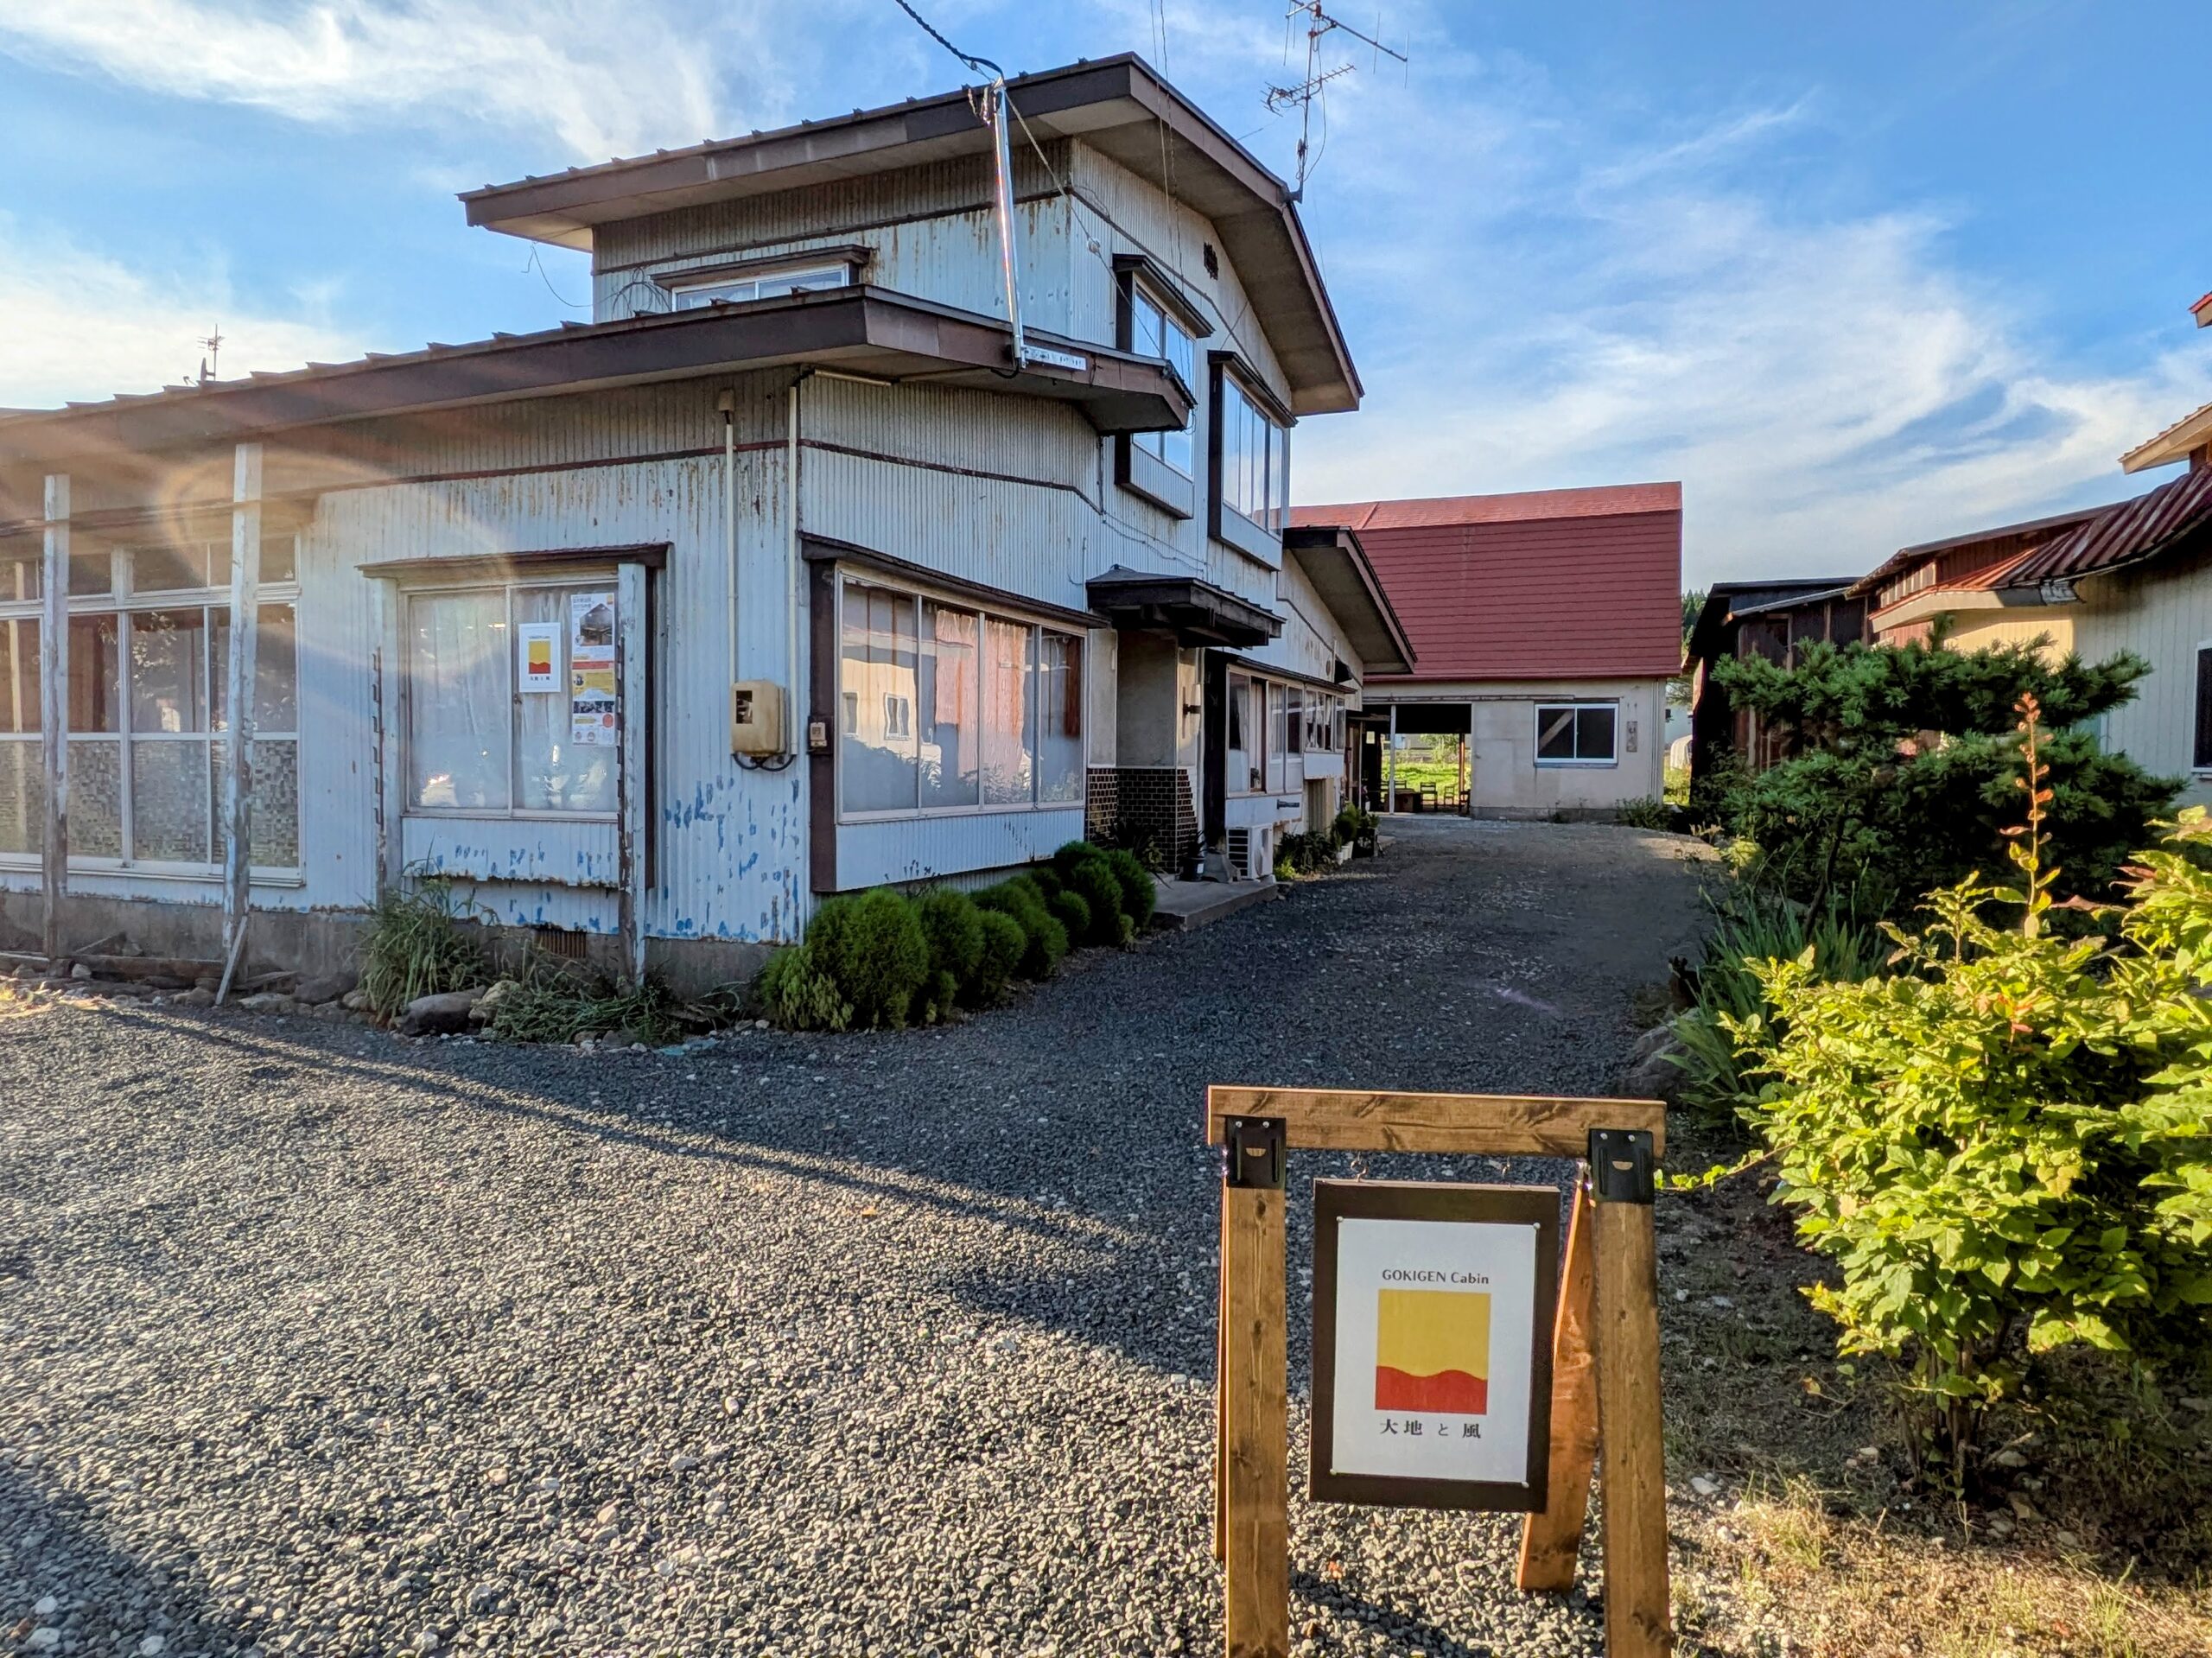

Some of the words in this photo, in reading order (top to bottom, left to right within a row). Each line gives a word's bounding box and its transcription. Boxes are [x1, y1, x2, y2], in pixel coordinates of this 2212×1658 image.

[1382, 1269, 1446, 1282] GOKIGEN
[1451, 1272, 1489, 1284] Cabin
[1380, 1419, 1481, 1439] 大地と風
